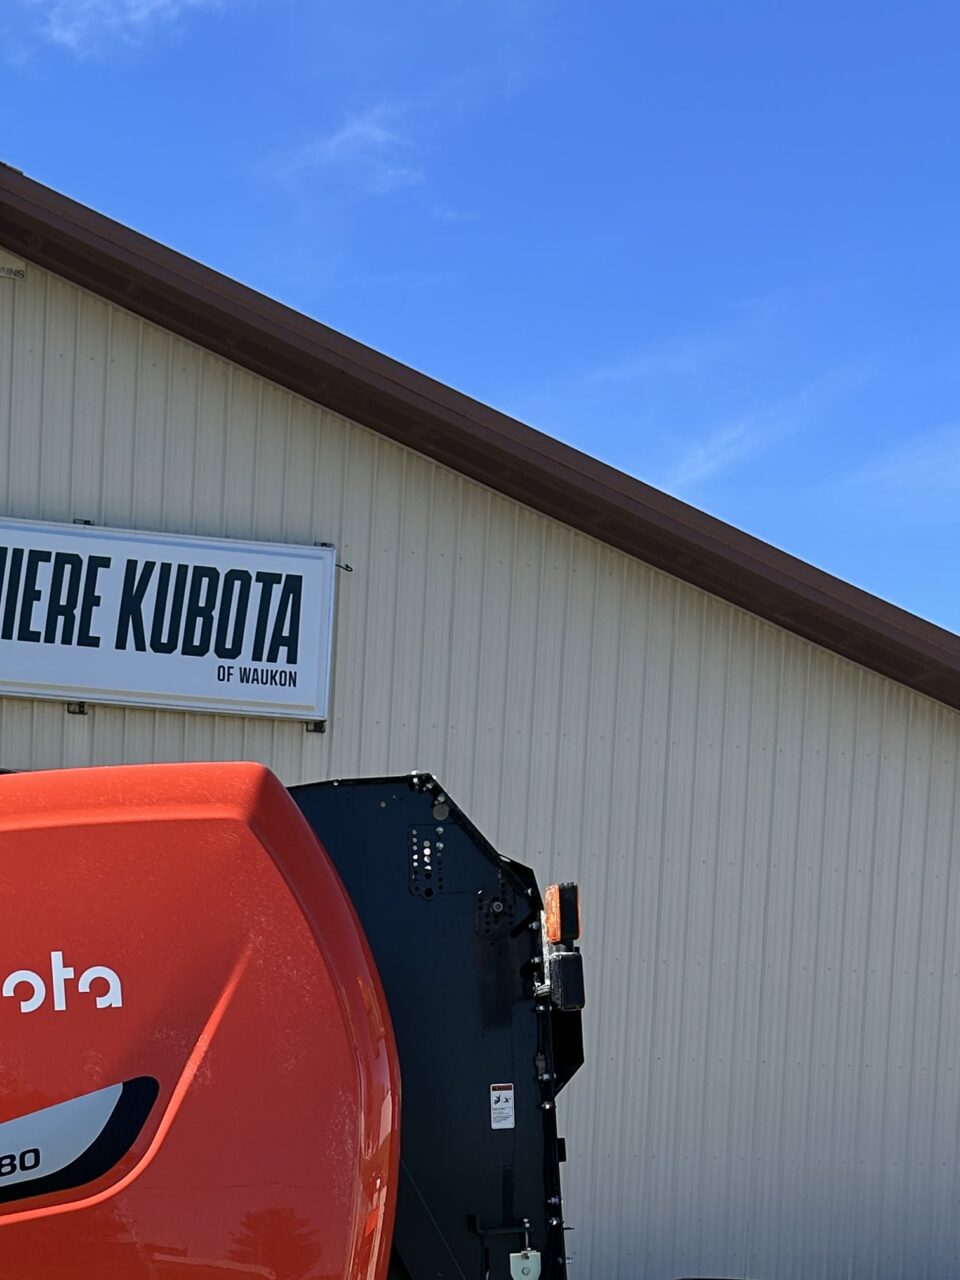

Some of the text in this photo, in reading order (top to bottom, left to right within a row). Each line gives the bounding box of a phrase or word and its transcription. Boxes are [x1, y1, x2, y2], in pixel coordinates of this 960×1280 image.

[115, 559, 304, 665] KUBOTA
[217, 665, 297, 688] OF WAUKON
